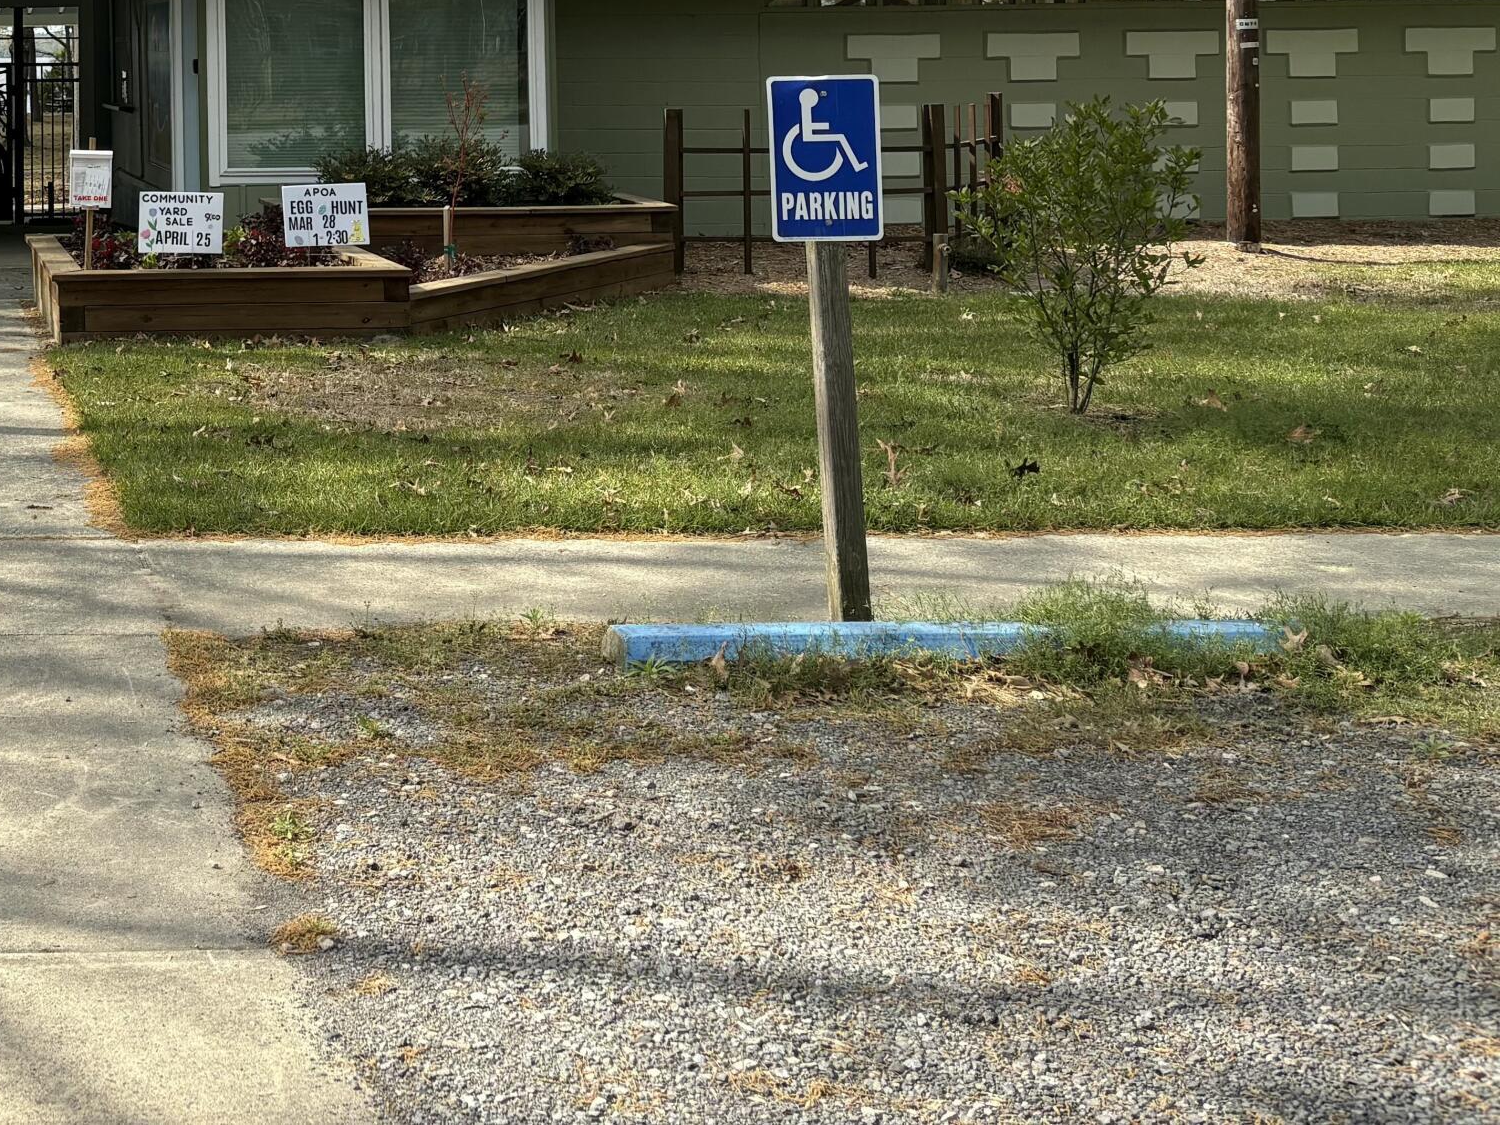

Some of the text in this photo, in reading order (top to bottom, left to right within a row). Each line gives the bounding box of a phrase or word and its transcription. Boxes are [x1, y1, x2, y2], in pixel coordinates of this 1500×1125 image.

[142, 193, 214, 204] COMMUNITY
[304, 188, 336, 197] APOA
[159, 206, 188, 216] YARD
[290, 200, 363, 215] EGG HUNT
[781, 191, 874, 221] PARKING
[165, 217, 194, 226] SALE
[288, 214, 336, 231] MAR 28
[155, 230, 212, 247] APRIL 25
